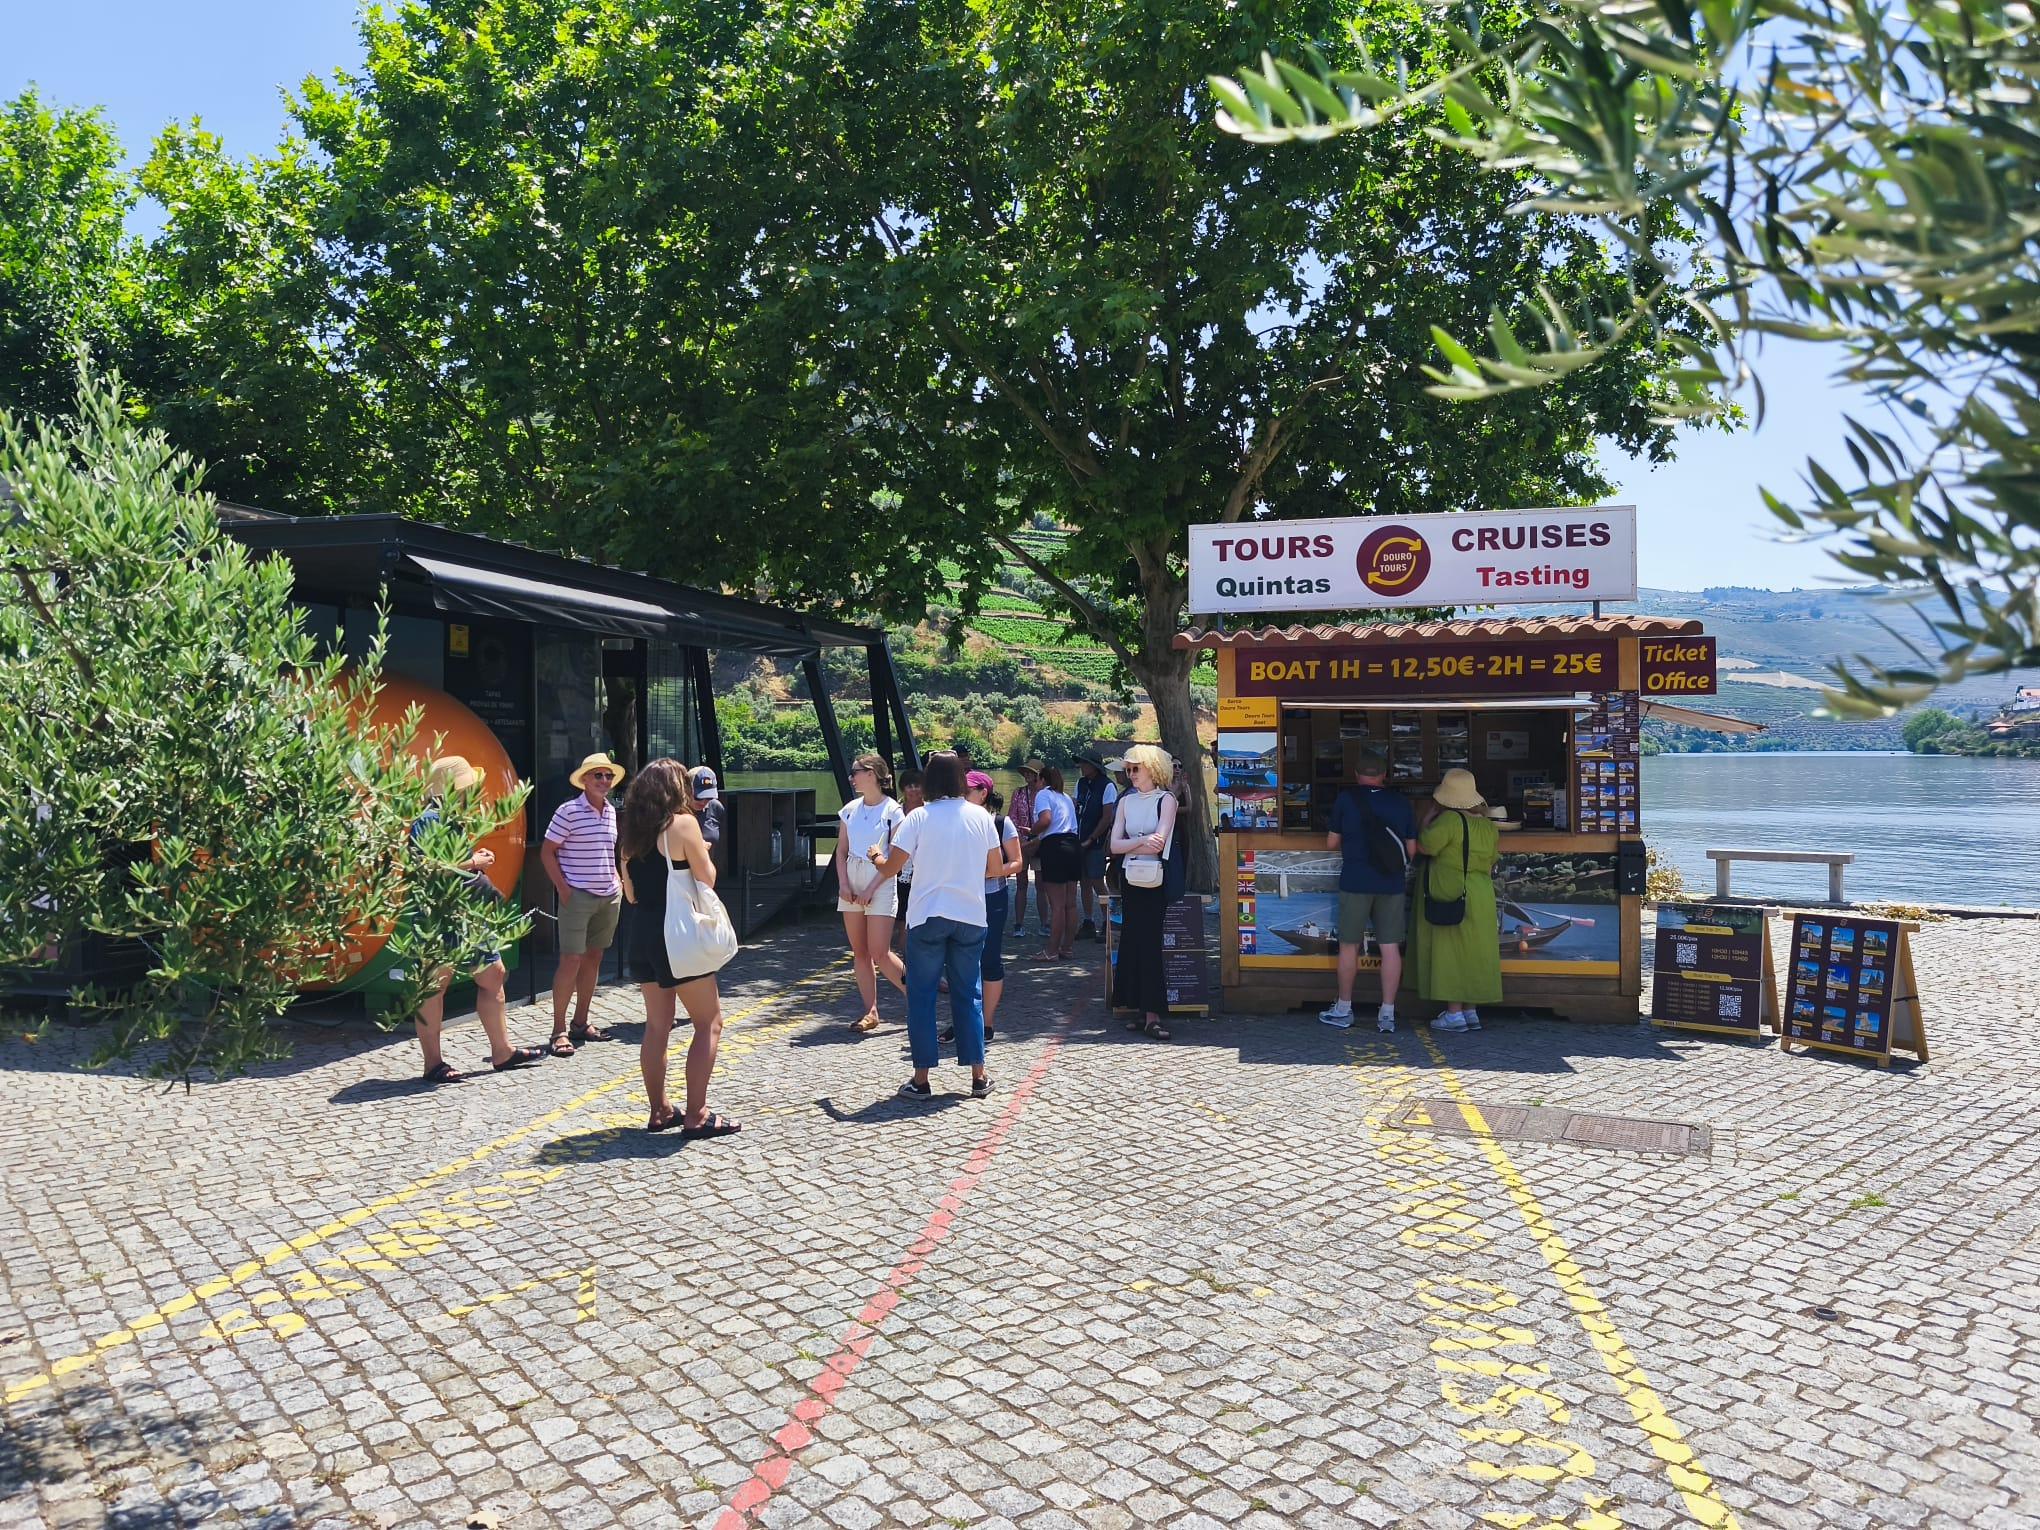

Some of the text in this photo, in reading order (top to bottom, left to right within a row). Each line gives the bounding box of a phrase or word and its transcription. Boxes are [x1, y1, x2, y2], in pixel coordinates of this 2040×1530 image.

[1212, 534, 1334, 562] TOURS
[1452, 522, 1611, 552] CRUISES
[1379, 563, 1407, 574] TOURS
[1383, 552, 1412, 563] DOURO
[1216, 575, 1331, 598] Quintas
[1476, 564, 1590, 589] Tasting
[1645, 643, 1708, 664] Ticket
[1251, 660, 1320, 682] BOAT
[1331, 659, 1359, 680] 1H
[1553, 652, 1602, 674] 25€
[1648, 670, 1710, 692] Office
